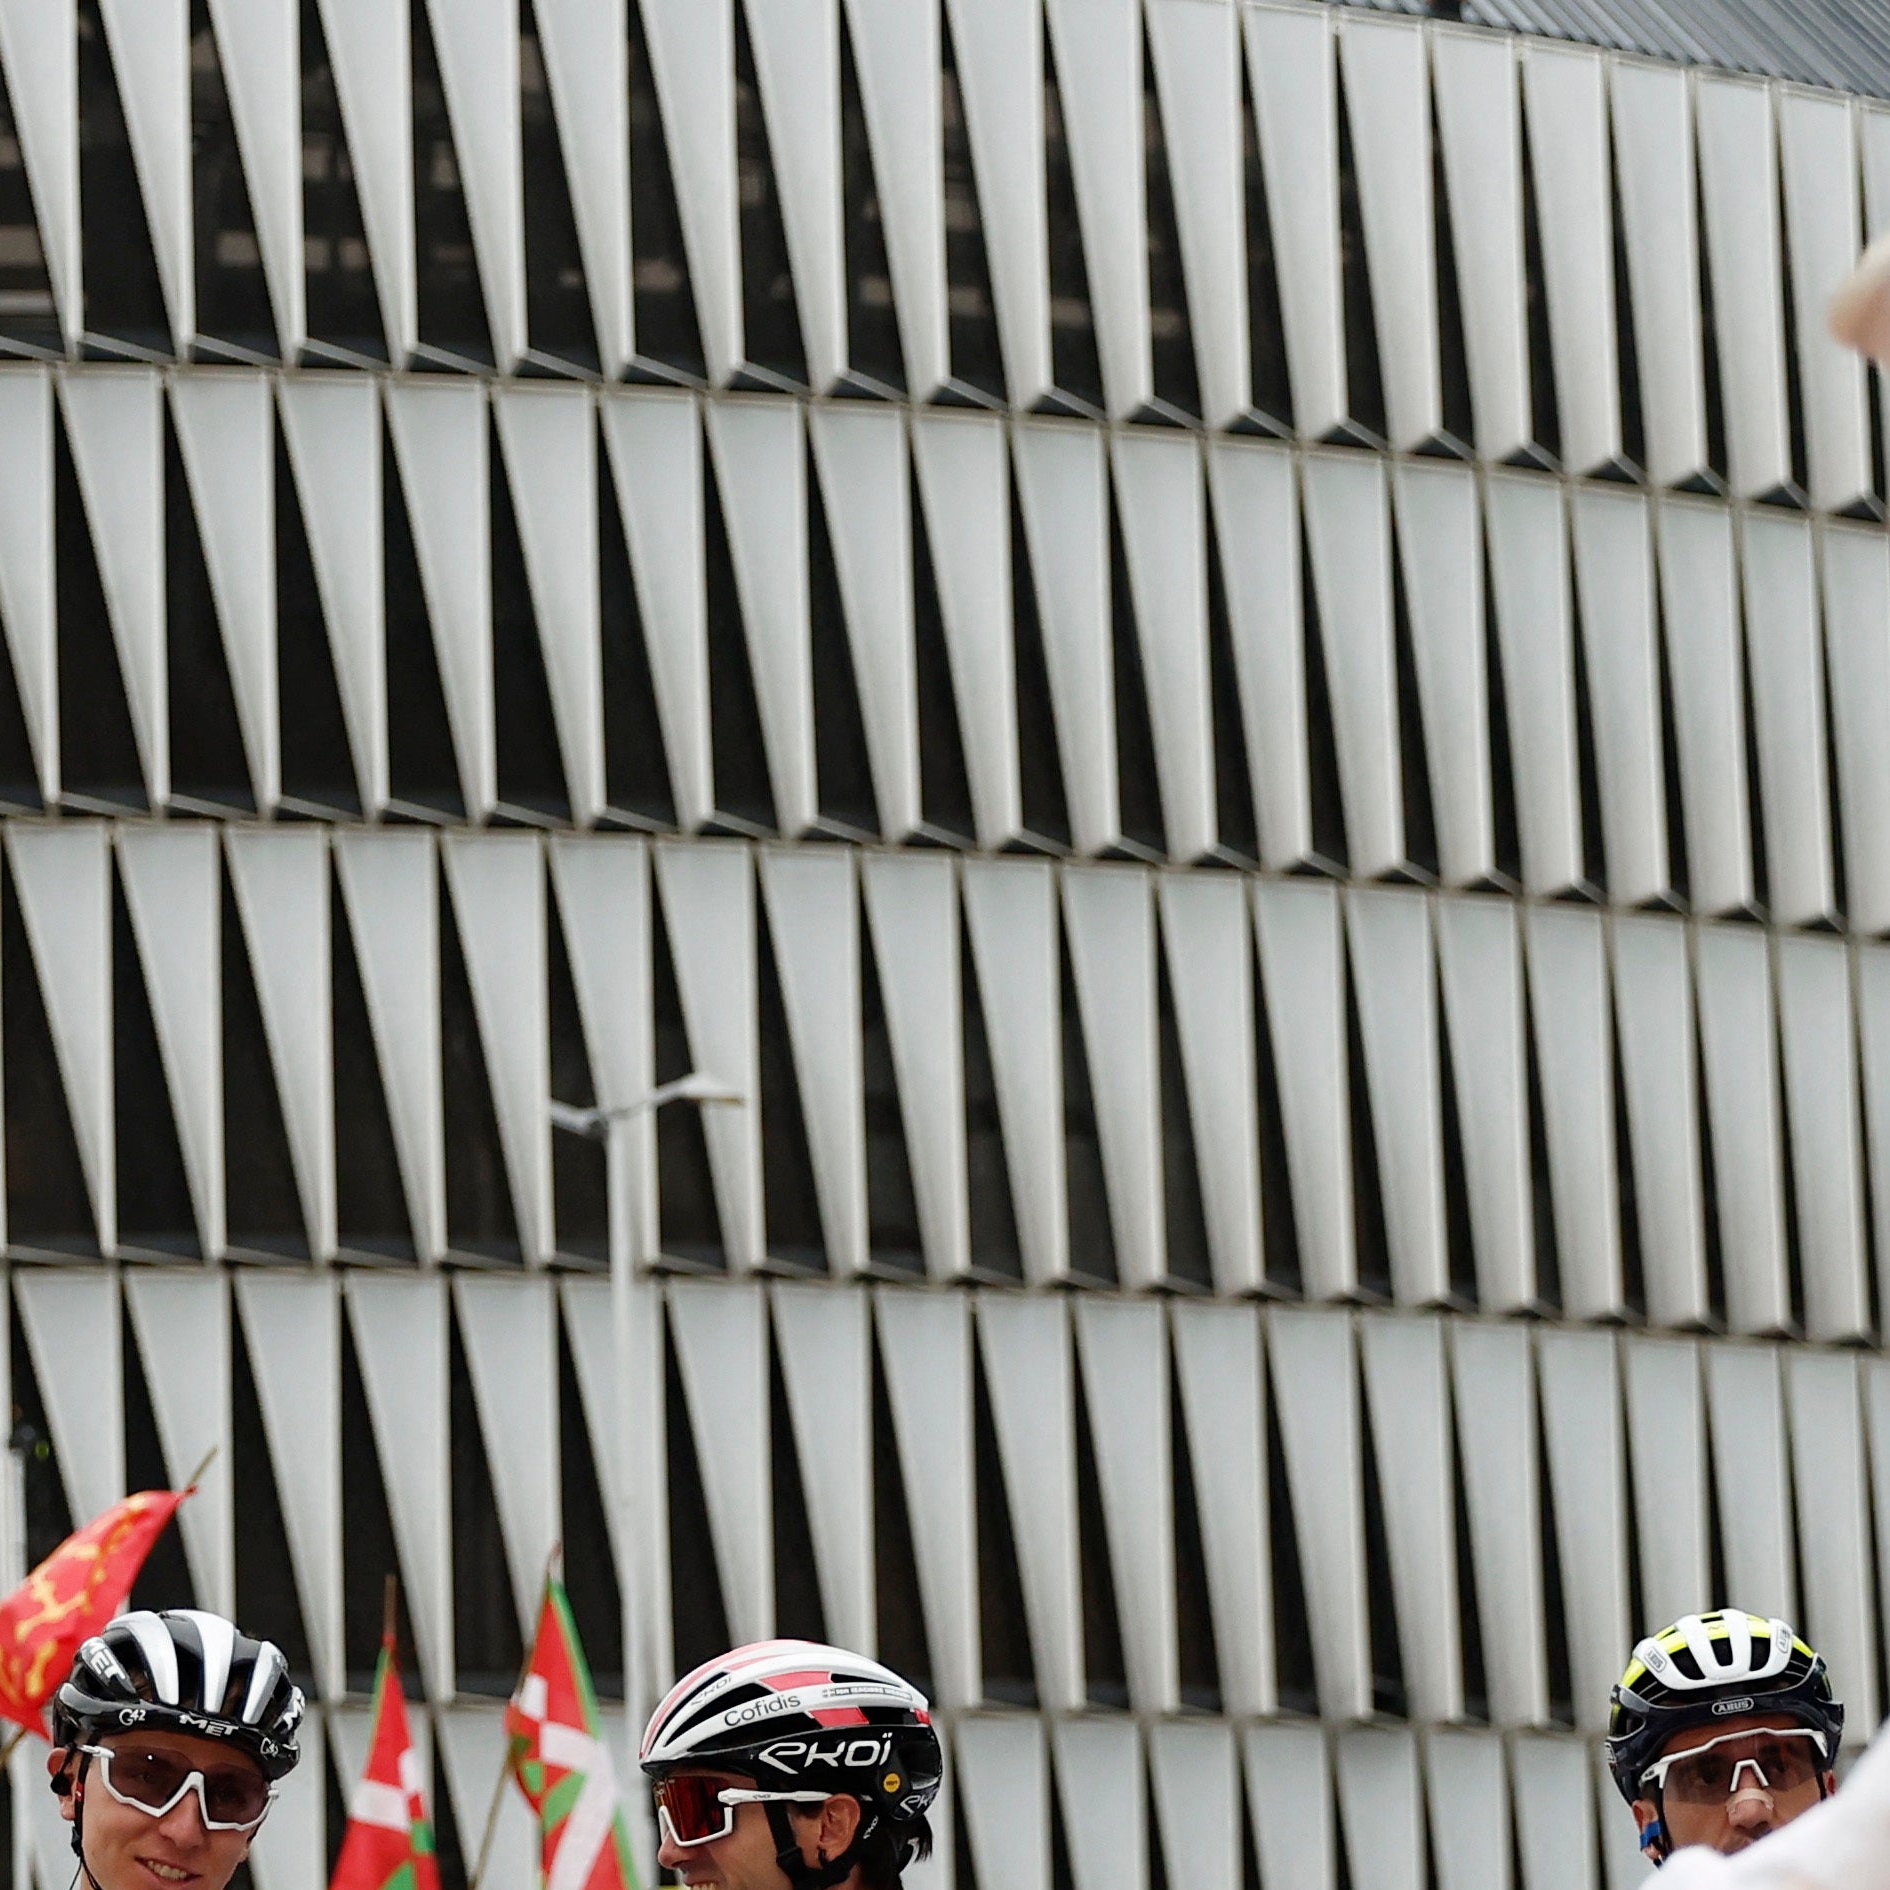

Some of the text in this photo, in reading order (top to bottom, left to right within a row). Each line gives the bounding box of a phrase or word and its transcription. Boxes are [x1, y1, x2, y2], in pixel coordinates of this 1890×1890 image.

[723, 1693, 802, 1728] Cofidis
[1717, 1699, 1749, 1714] ABUS
[118, 1708, 146, 1727] G42
[178, 1713, 240, 1737] MET
